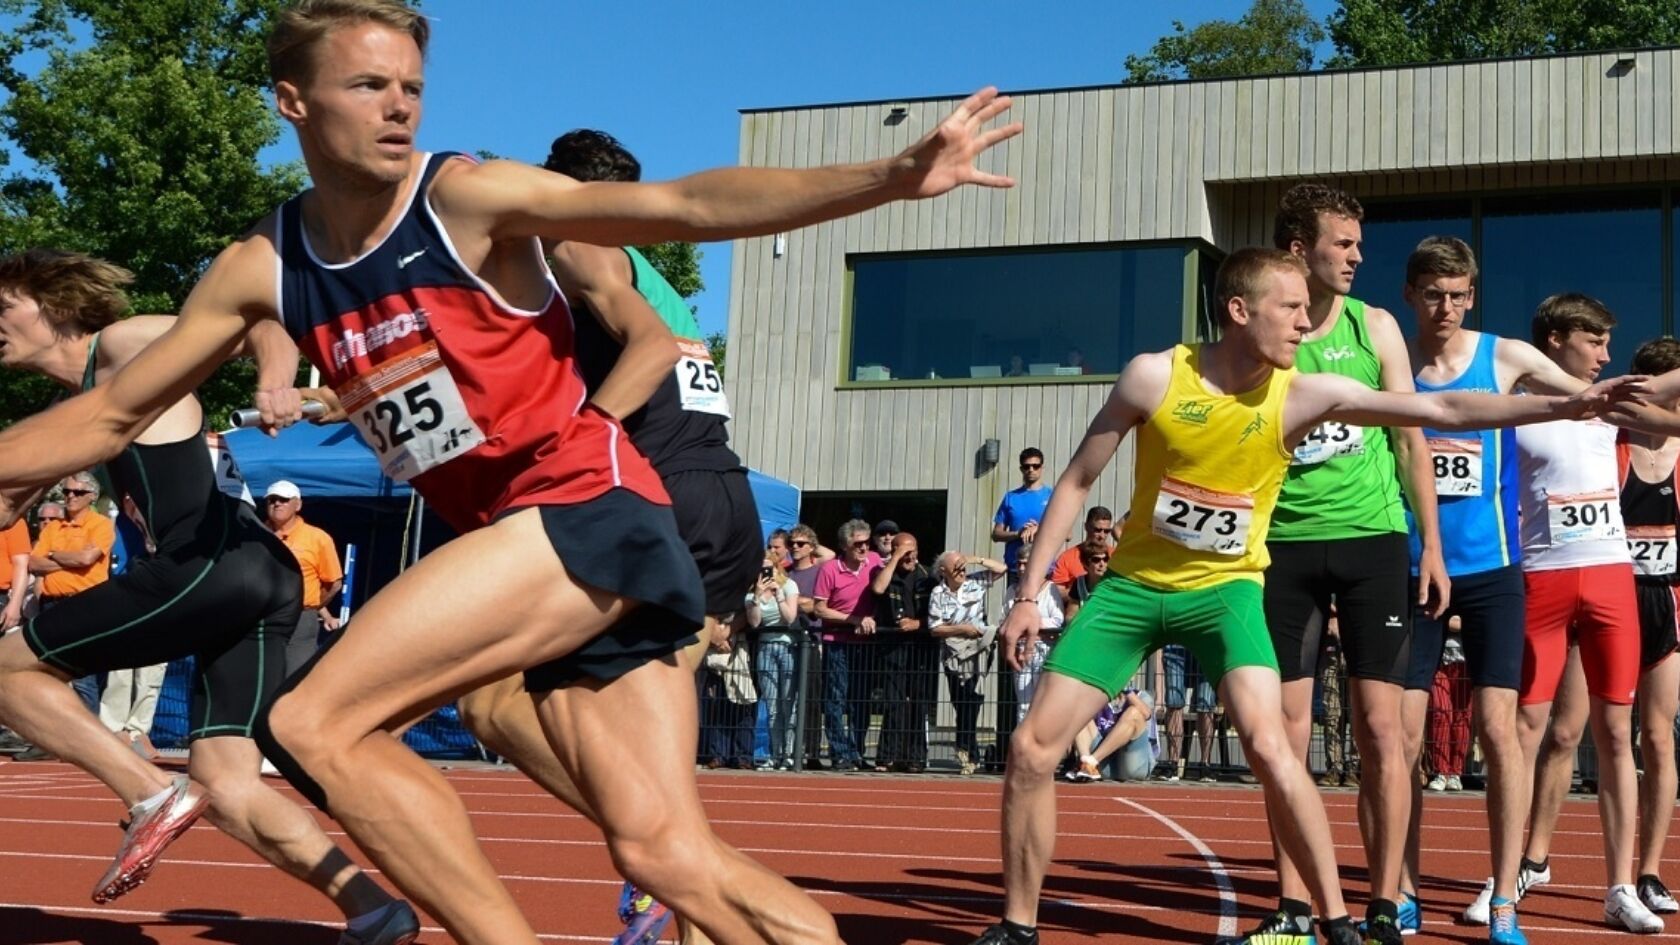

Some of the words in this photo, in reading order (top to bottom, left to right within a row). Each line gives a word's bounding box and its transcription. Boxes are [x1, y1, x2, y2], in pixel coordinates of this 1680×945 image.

[686, 360, 720, 393] 25
[363, 381, 444, 454] 325
[1298, 420, 1350, 445] 43
[1165, 499, 1238, 535] 273
[1560, 502, 1609, 527] 301
[1627, 540, 1669, 561] 27
